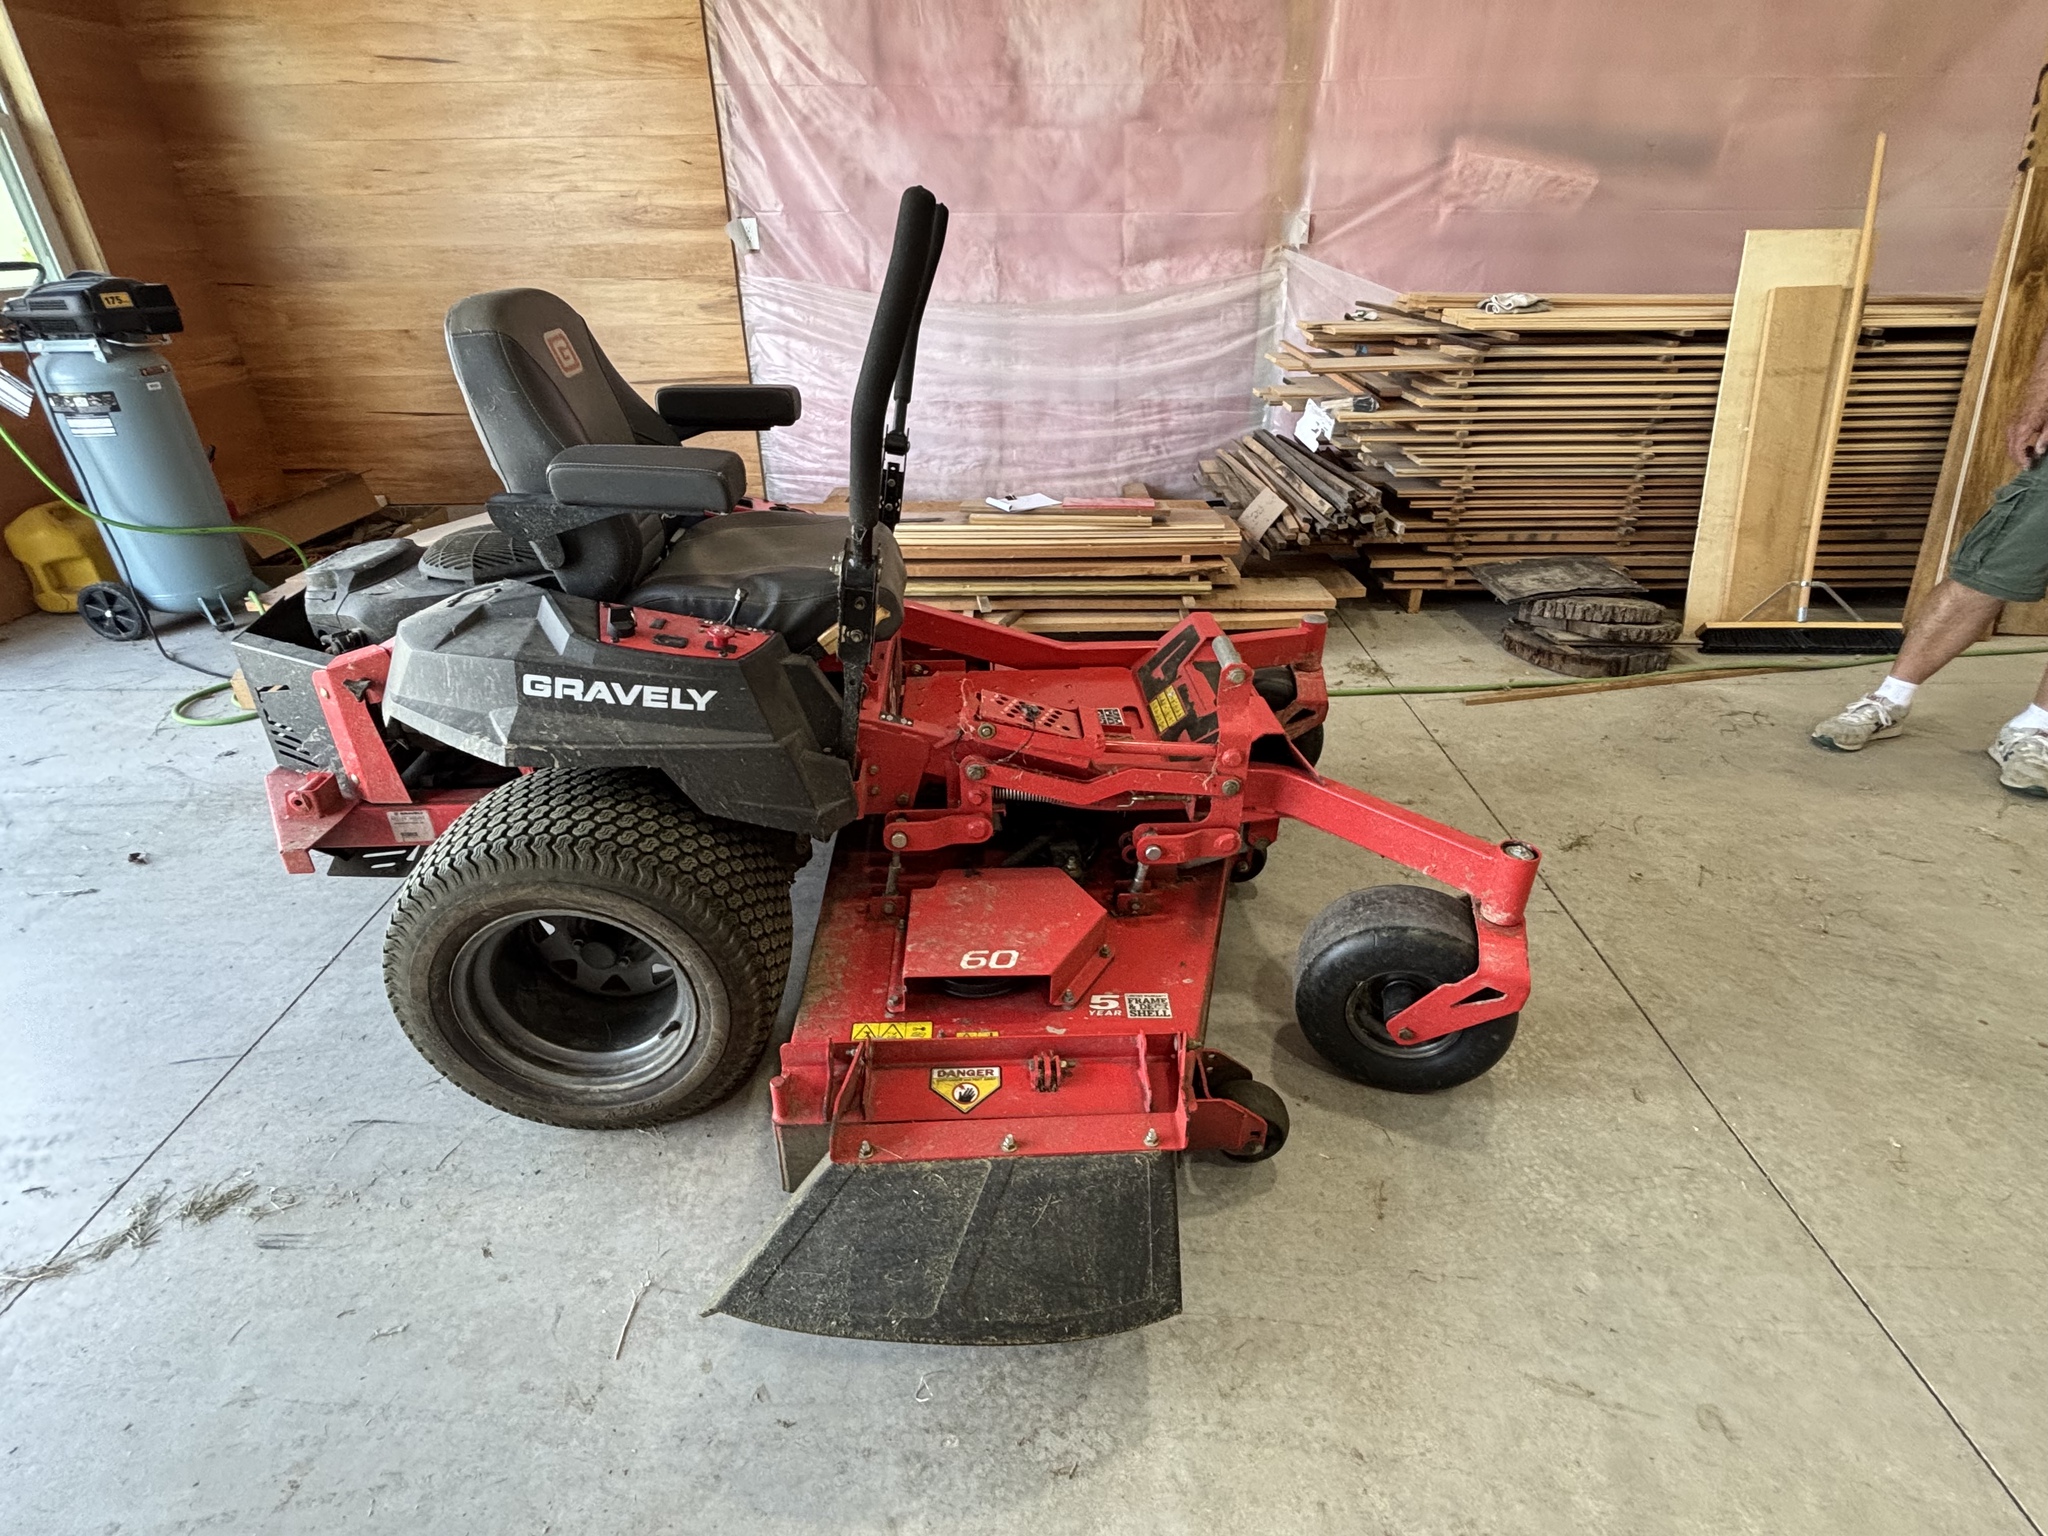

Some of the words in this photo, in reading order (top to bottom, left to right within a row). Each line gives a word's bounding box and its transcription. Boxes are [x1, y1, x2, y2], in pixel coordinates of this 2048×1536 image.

[104, 295, 123, 305] 175
[522, 673, 718, 711] GRAVELY
[960, 949, 1019, 969] 60
[1089, 994, 1120, 1010] 5
[937, 1069, 995, 1078] DANGER
